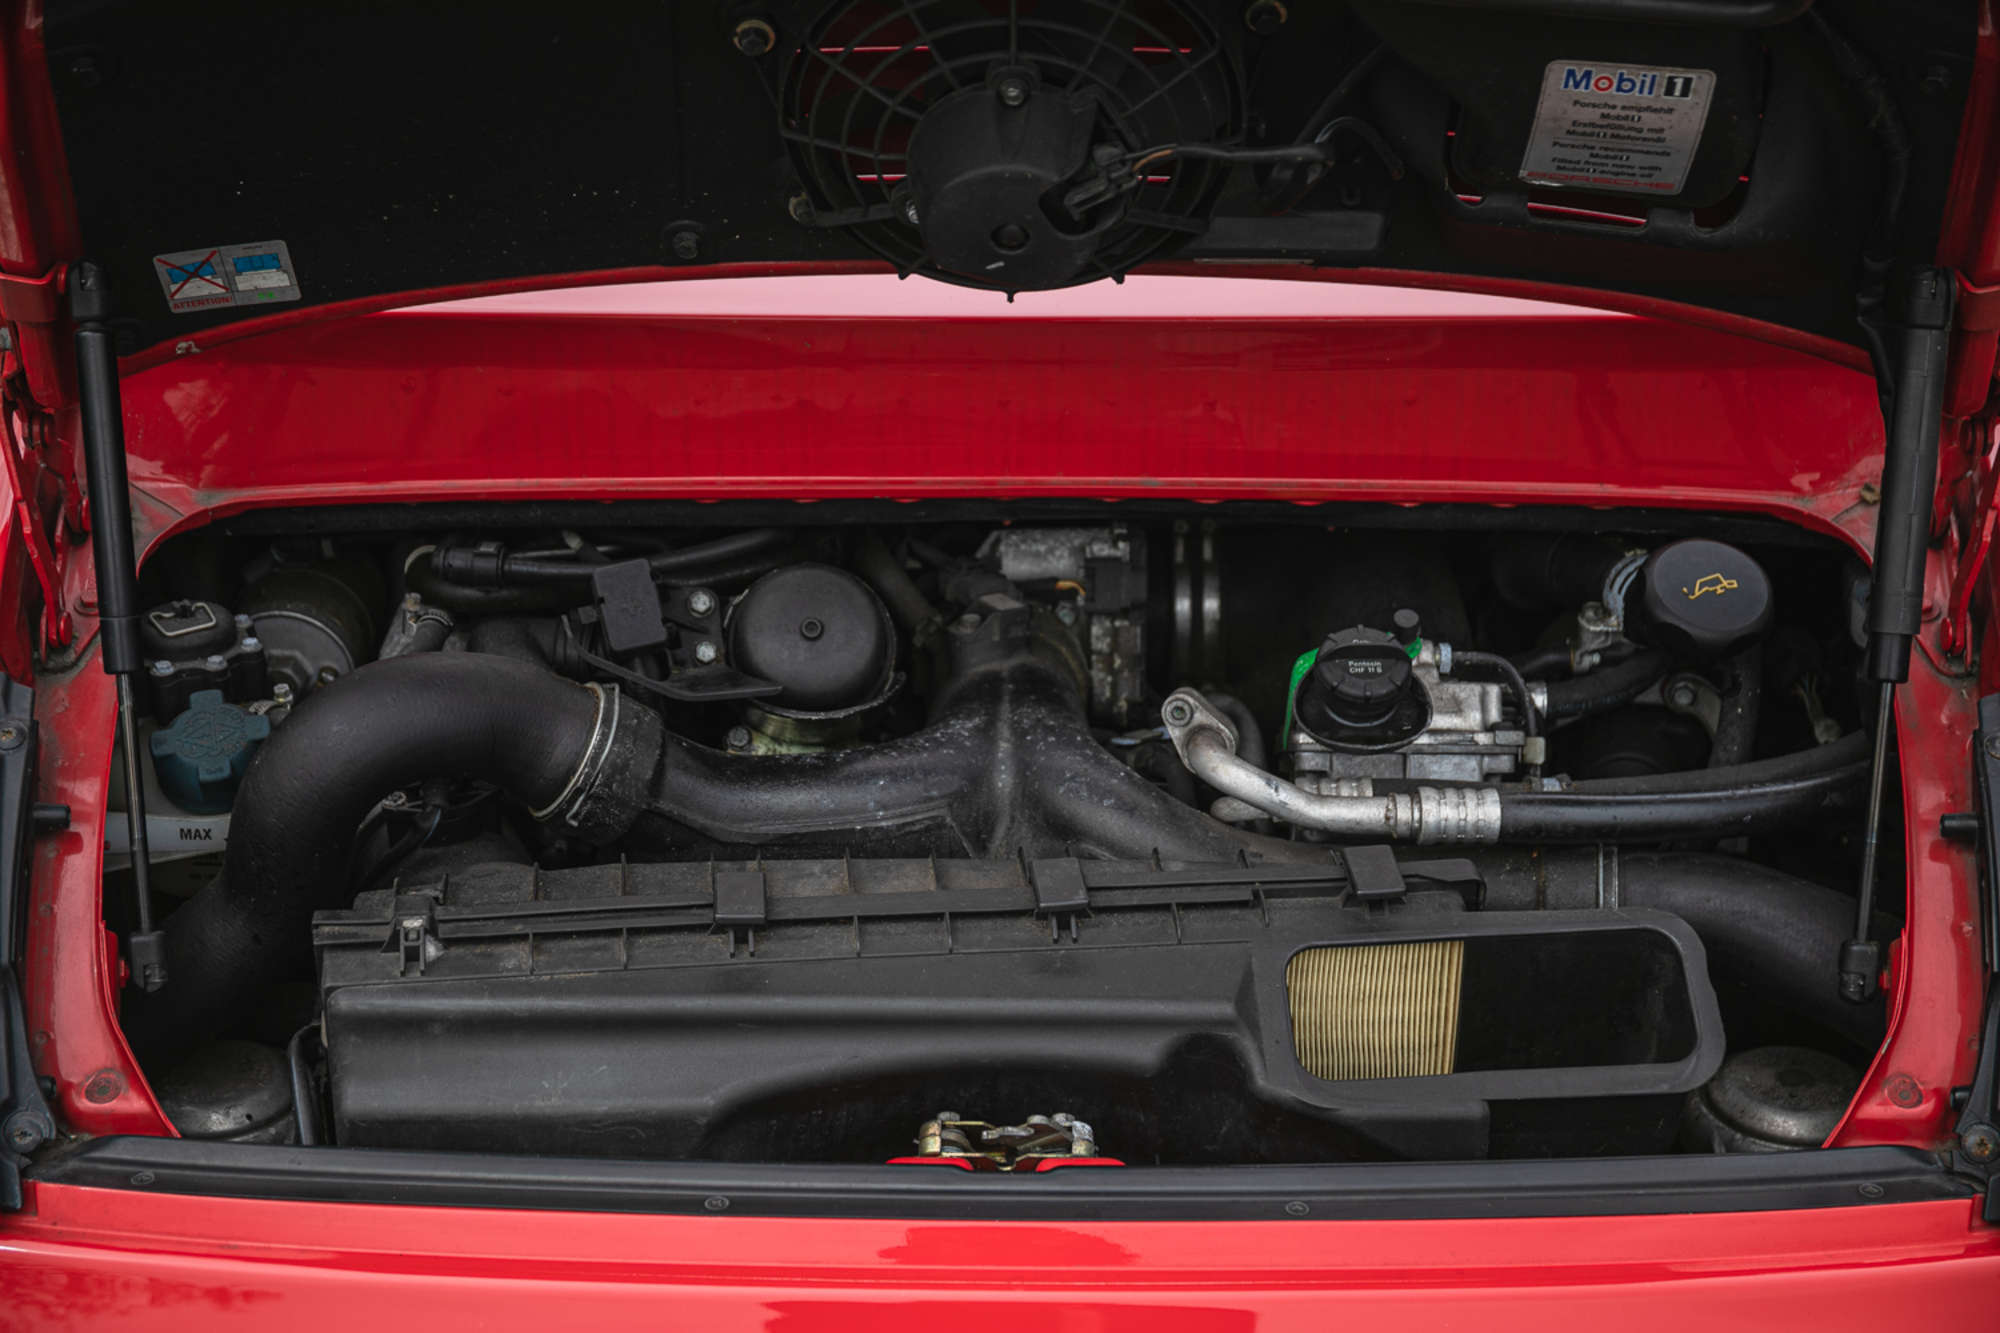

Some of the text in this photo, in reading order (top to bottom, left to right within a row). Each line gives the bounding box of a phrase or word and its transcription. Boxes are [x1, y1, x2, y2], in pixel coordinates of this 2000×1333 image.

[1563, 68, 1657, 95] Mobil
[1572, 99, 1675, 115] Porsche empfiehlt
[1599, 112, 1629, 122] Mobil
[1566, 128, 1595, 138] Mobil
[1552, 140, 1672, 158] Porsche recommends
[1589, 151, 1618, 161] Mobil
[180, 828, 212, 840] MAX
